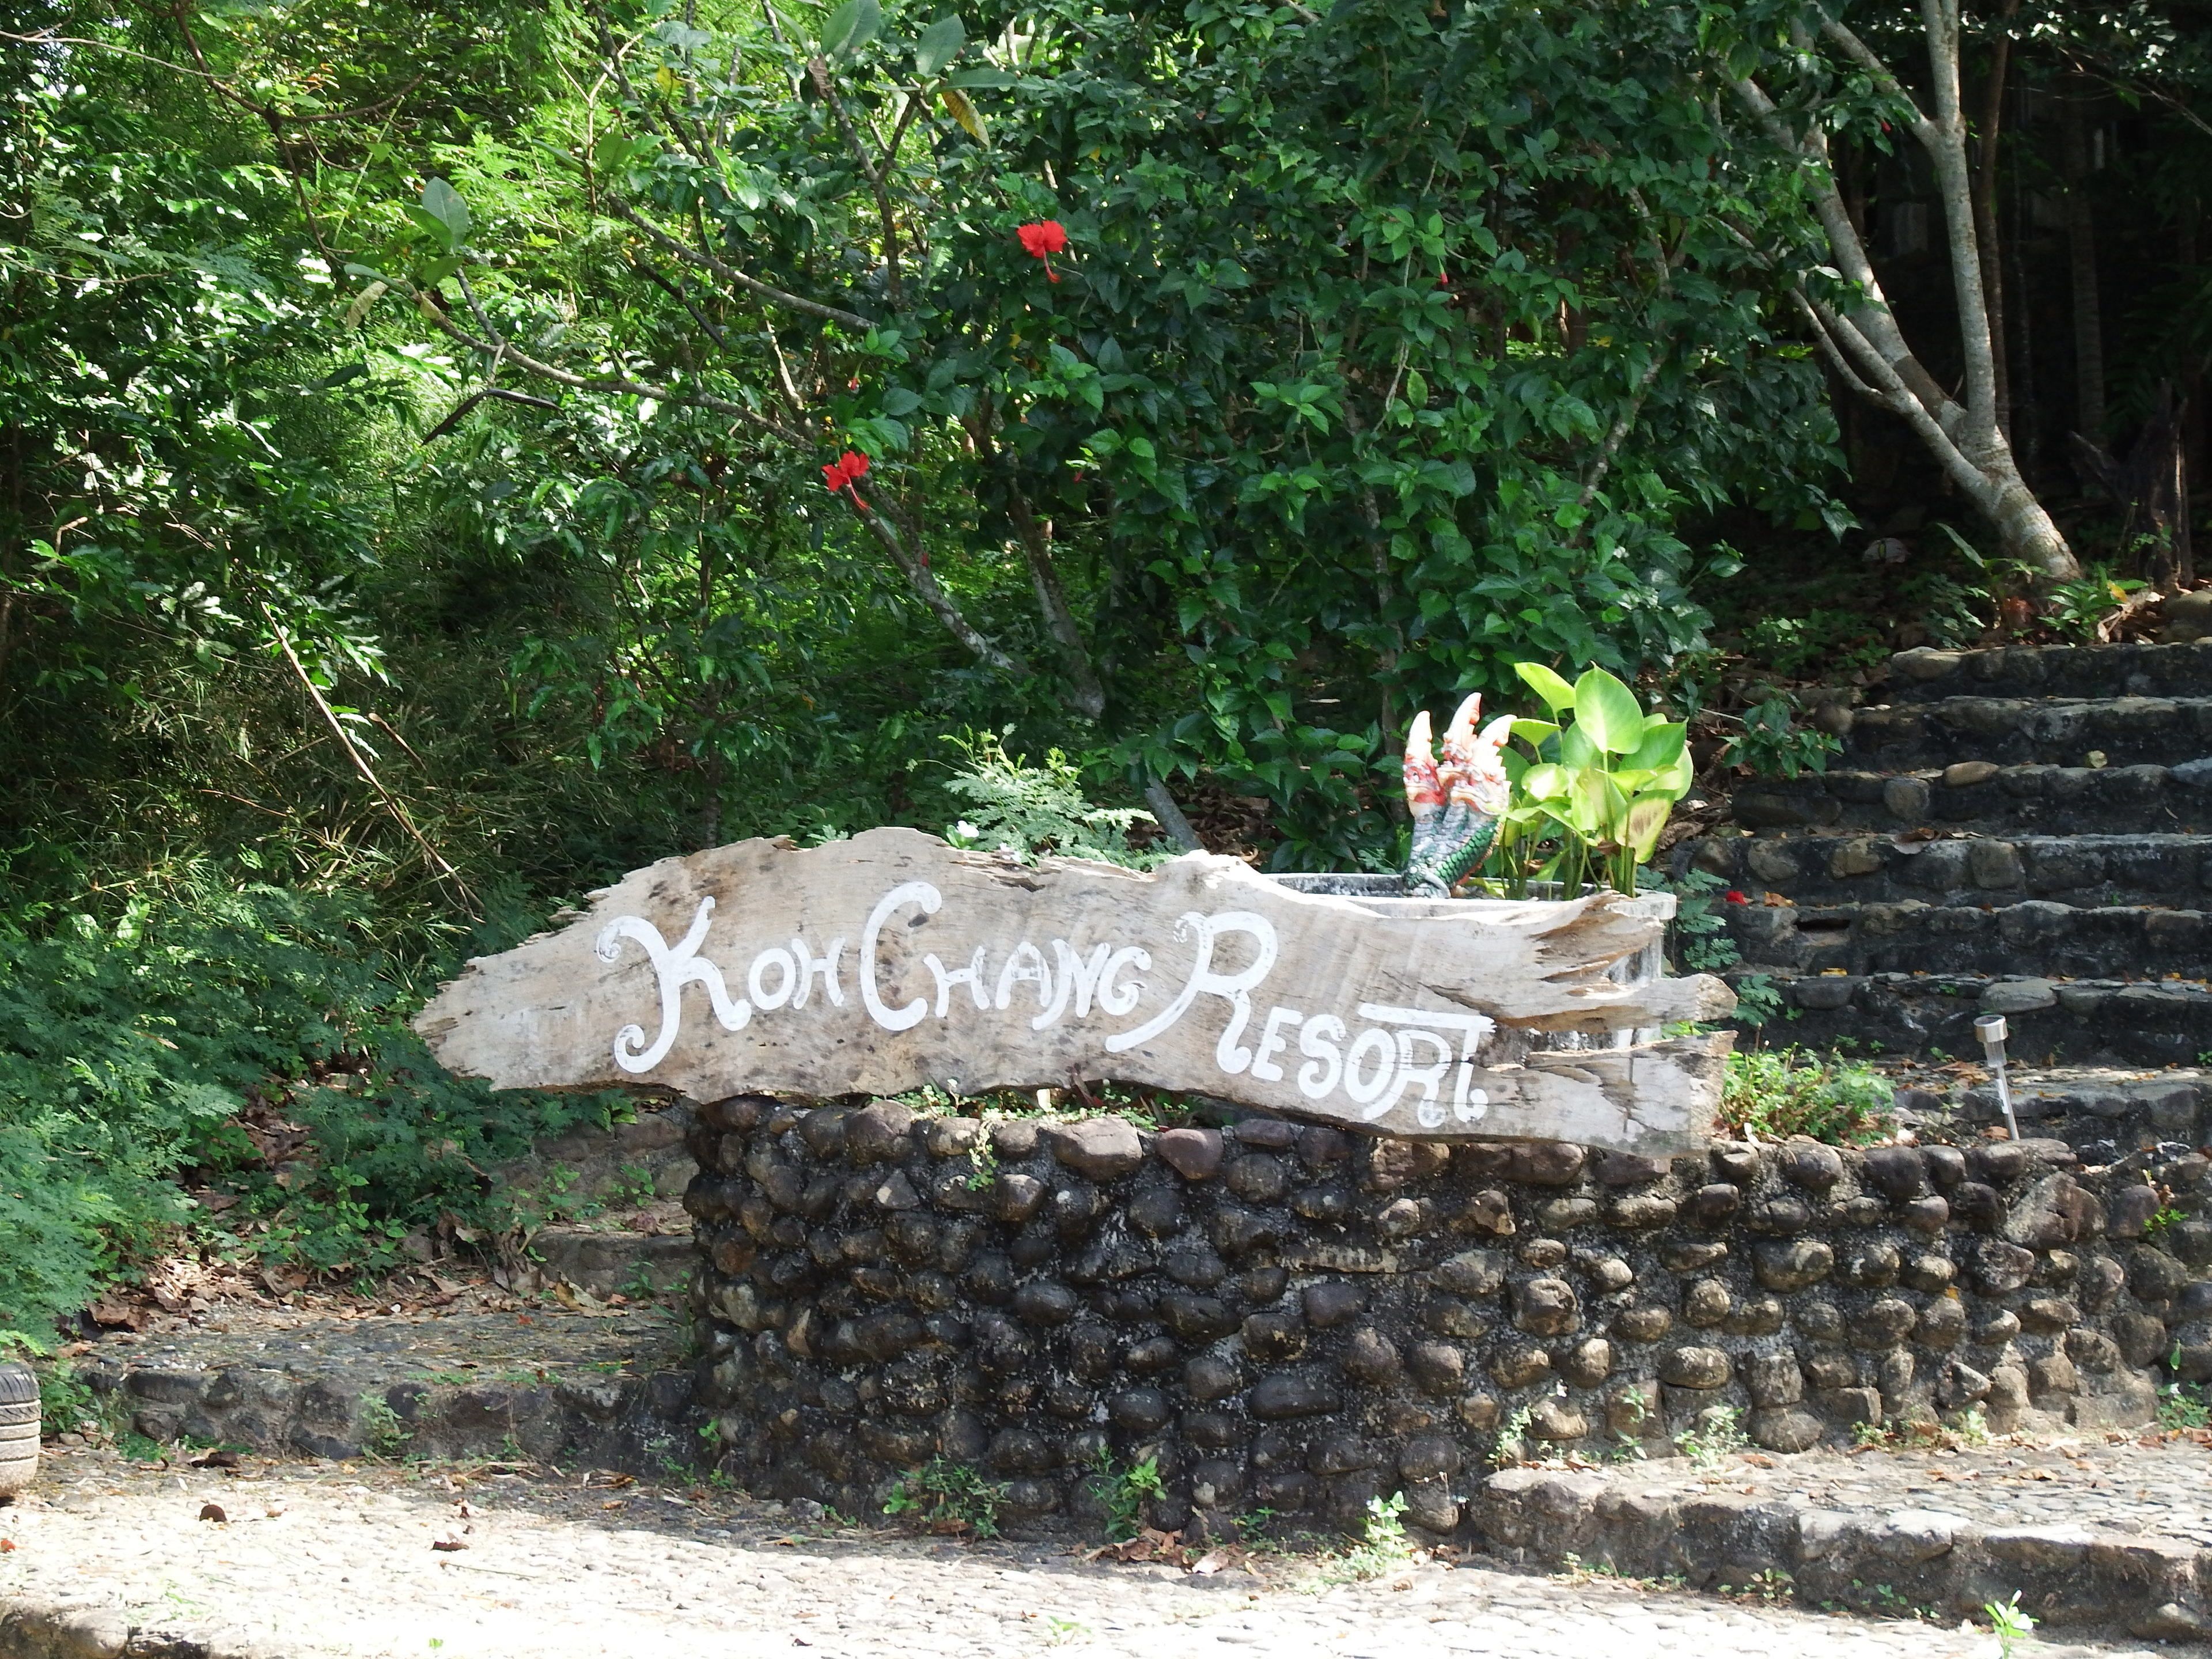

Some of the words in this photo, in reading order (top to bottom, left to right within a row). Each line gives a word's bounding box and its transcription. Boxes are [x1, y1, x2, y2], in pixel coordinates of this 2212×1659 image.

[596, 895, 846, 1074] KOH
[860, 881, 1152, 1031] CHANG
[1105, 911, 1496, 1128] RESORT
